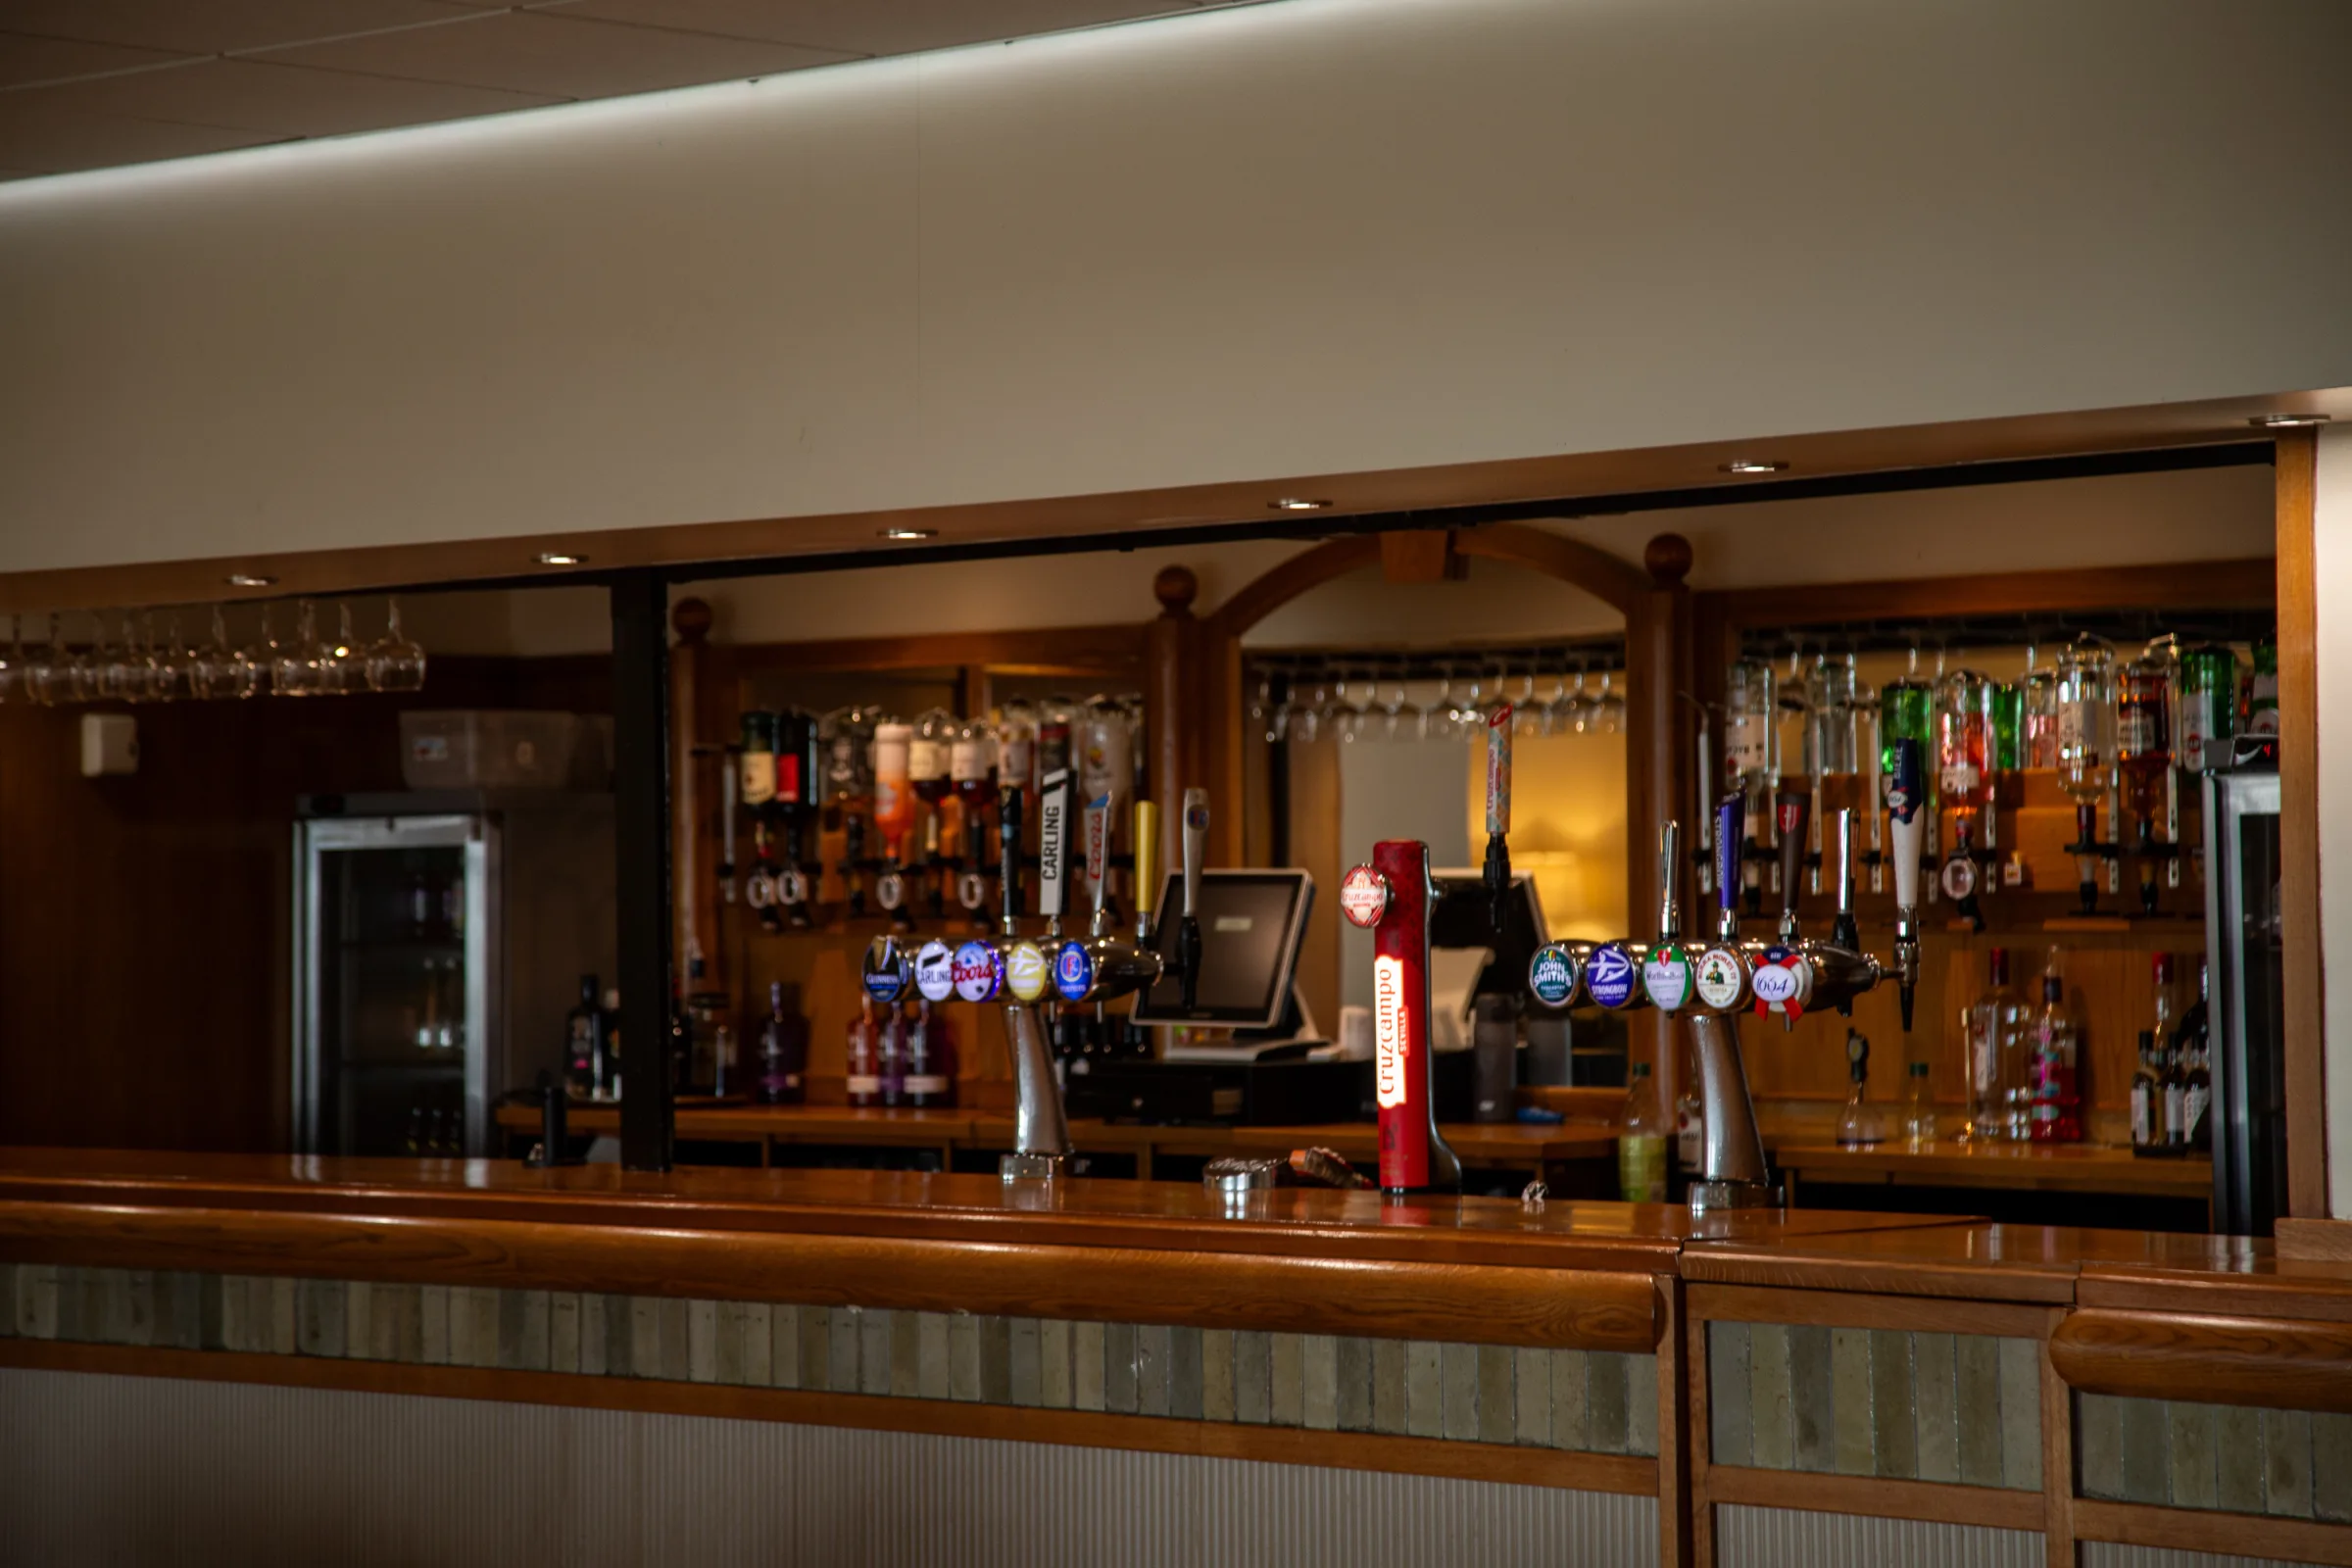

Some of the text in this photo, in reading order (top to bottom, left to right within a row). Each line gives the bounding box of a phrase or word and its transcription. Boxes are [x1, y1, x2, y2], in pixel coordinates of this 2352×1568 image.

[1042, 805, 1059, 880] CARLING
[1089, 810, 1102, 880] Coors
[950, 960, 994, 984] Coors
[1538, 960, 1566, 973] JOHN
[1534, 971, 1572, 988] SMITH'S
[1592, 984, 1628, 996] STRONGBOW
[1756, 977, 1788, 996] 1664
[1379, 968, 1396, 1095] Cruzcampo
[1398, 1010, 1407, 1053] SEVILLA
